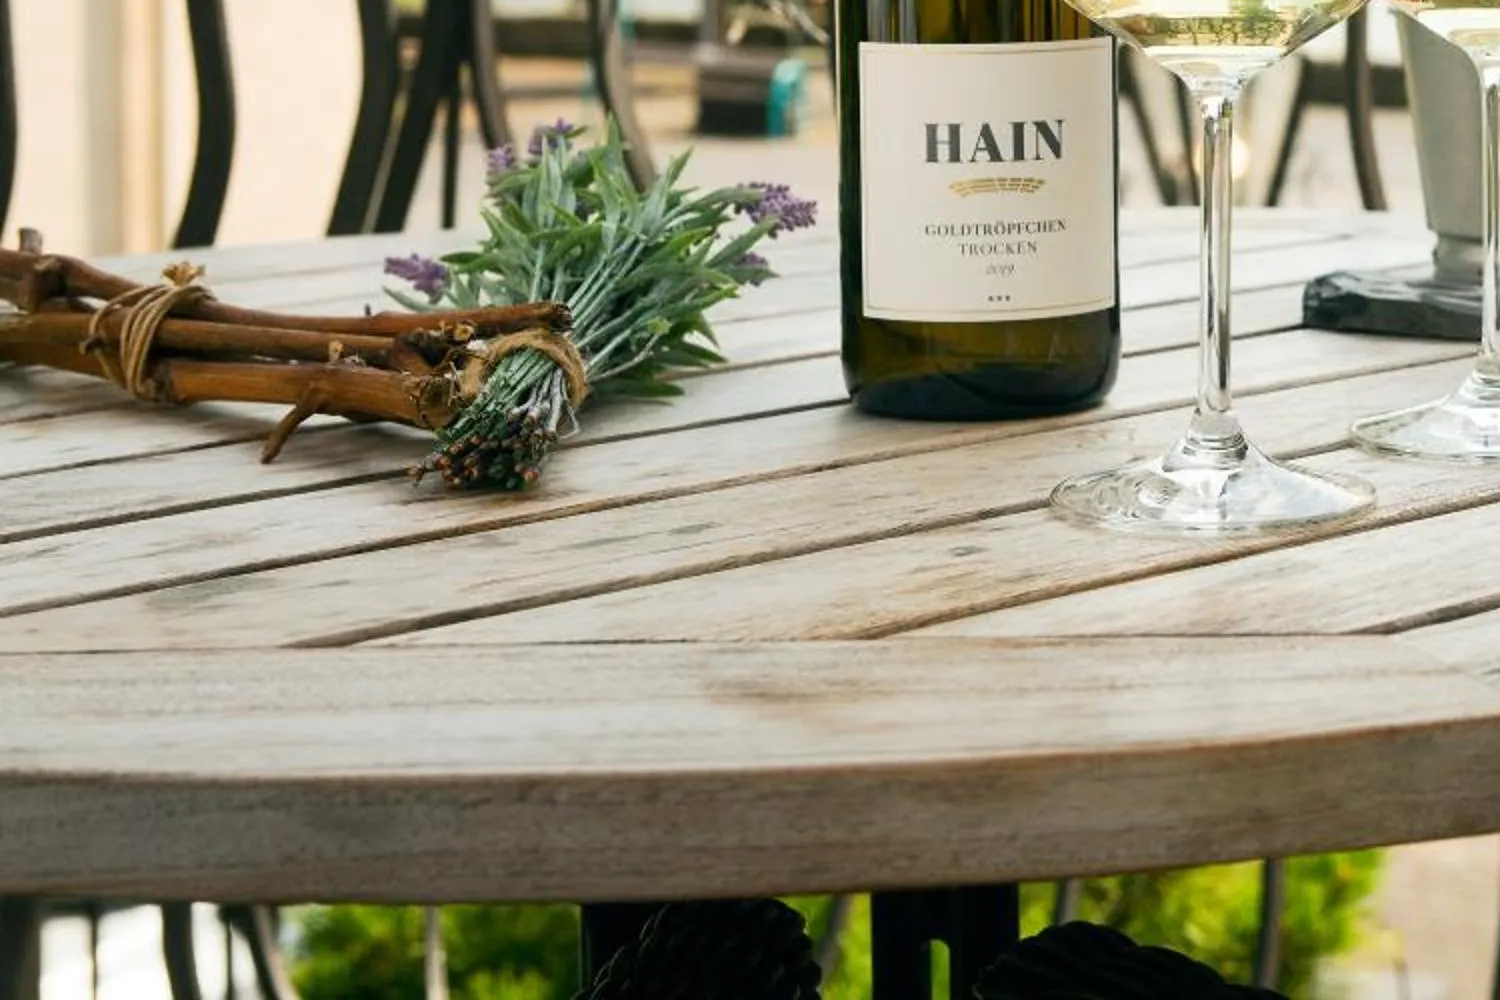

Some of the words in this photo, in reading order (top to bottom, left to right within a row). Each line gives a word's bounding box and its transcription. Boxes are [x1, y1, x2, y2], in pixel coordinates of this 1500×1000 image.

[925, 119, 1065, 163] HAIN
[925, 219, 1067, 237] GOLDTRÖPFCHEN
[958, 240, 1038, 257] TROCKEN
